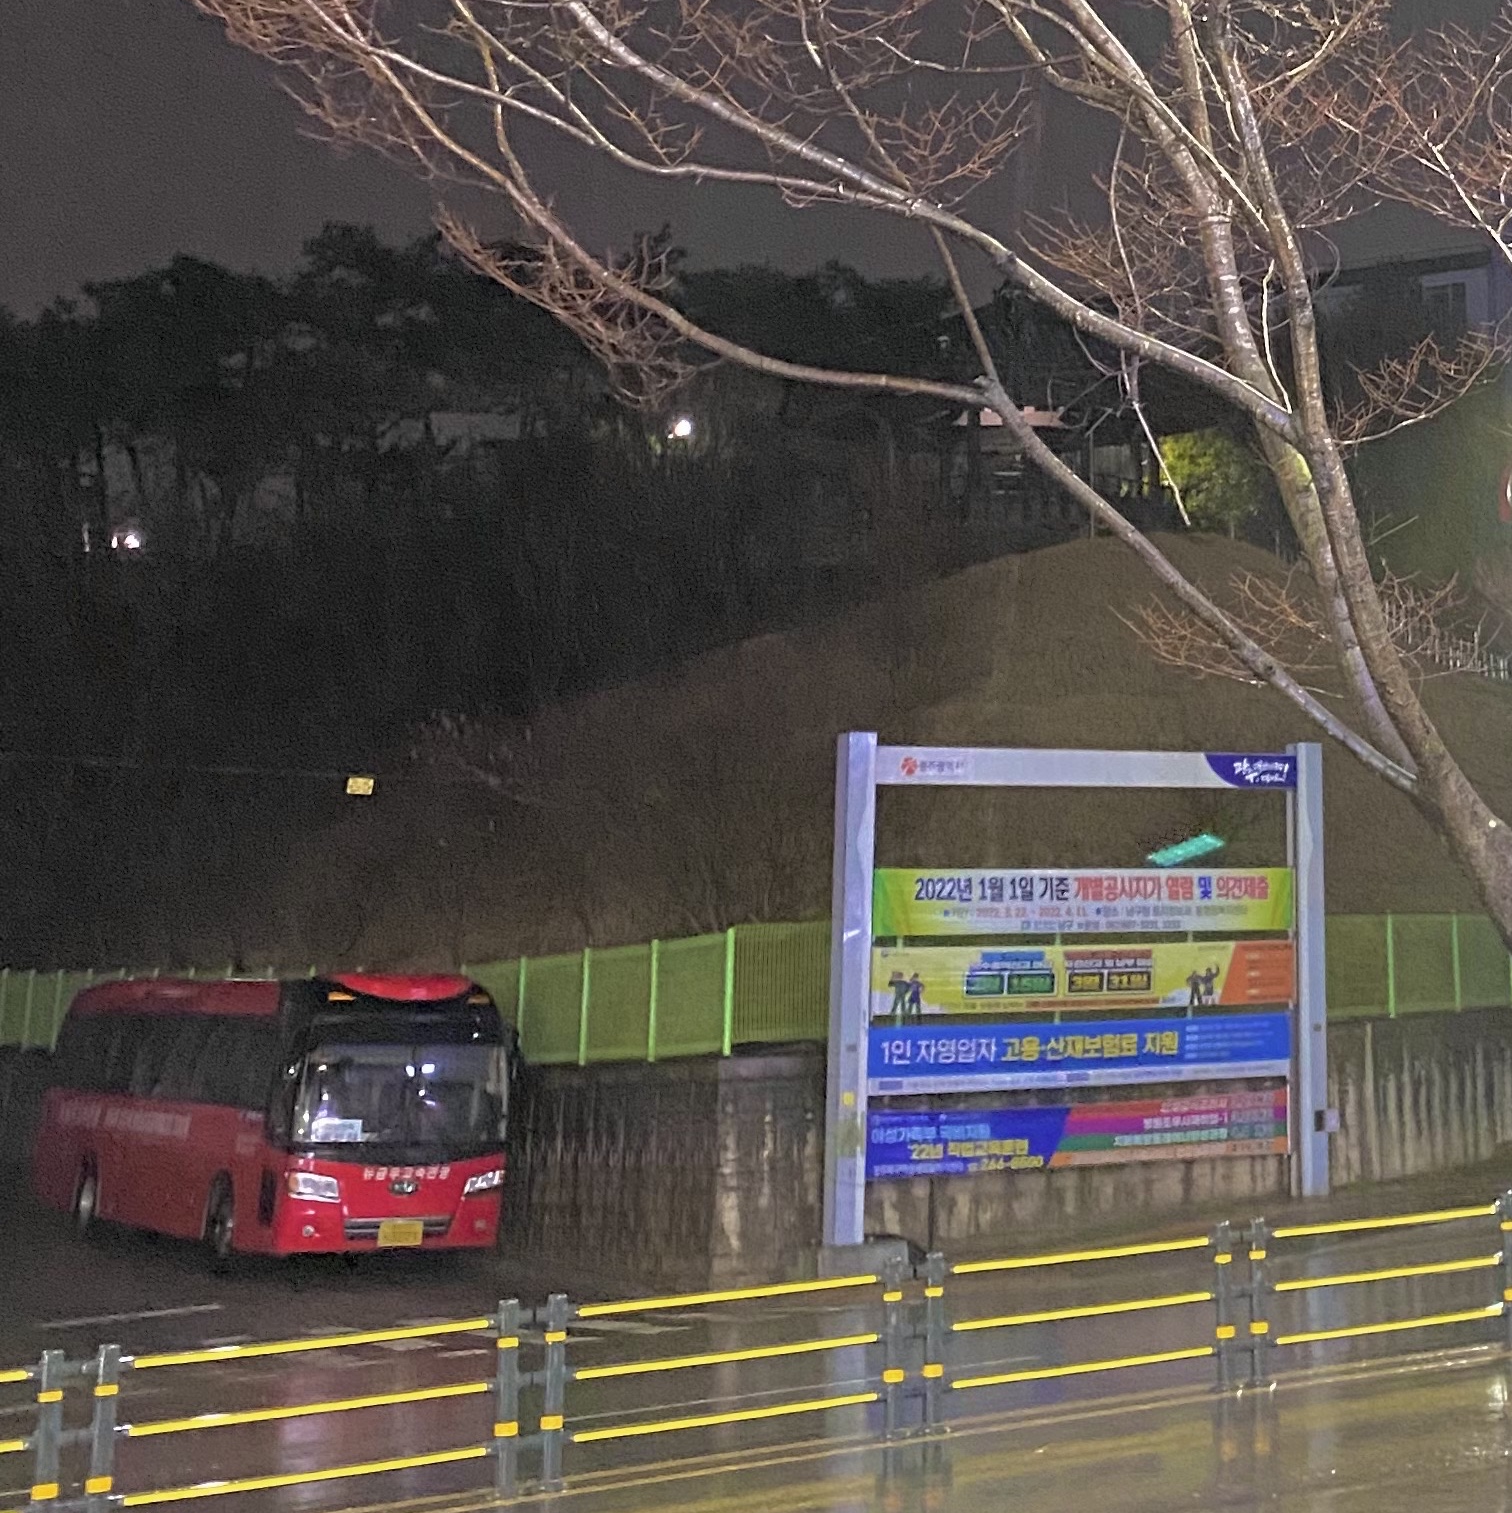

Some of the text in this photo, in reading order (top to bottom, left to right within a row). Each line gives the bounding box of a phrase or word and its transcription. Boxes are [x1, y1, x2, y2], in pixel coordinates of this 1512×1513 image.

[914, 876, 973, 902] 2022년
[978, 876, 1004, 903] 1월
[1009, 876, 1034, 902] 1일
[1039, 876, 1070, 902] 기준
[1073, 875, 1162, 902] 개별공시지가
[1198, 875, 1213, 900] 및
[1216, 875, 1270, 901] 의견제출
[880, 1039, 911, 1065] 1인
[915, 1037, 998, 1064] 자영업자
[1141, 1030, 1180, 1056] 지원
